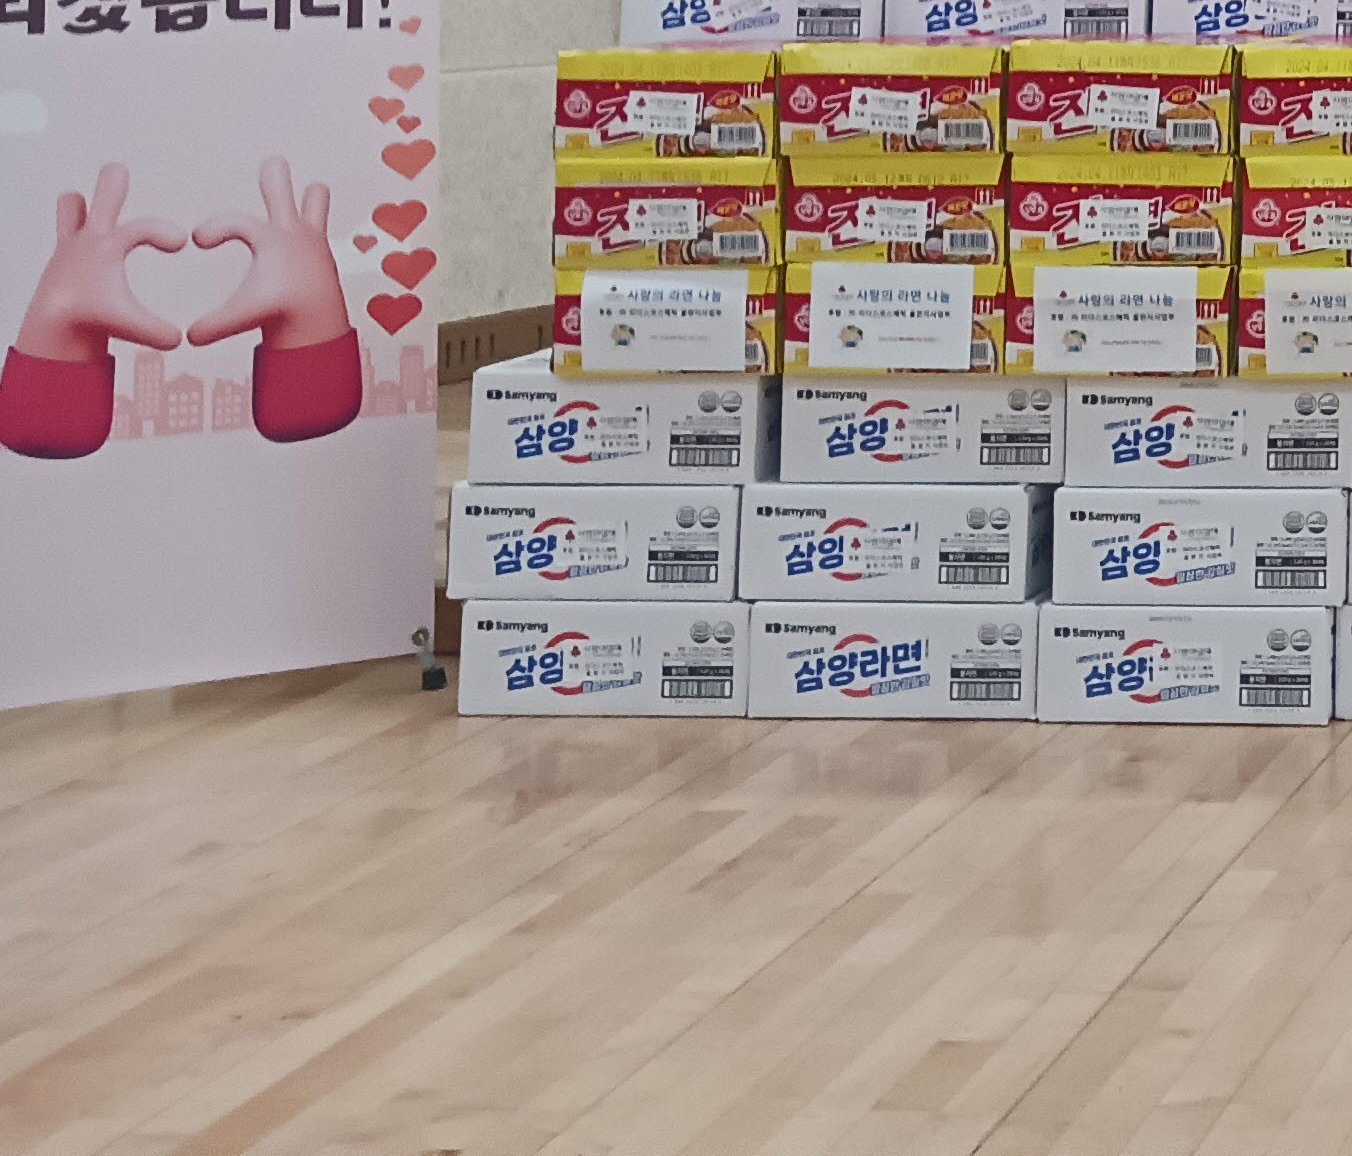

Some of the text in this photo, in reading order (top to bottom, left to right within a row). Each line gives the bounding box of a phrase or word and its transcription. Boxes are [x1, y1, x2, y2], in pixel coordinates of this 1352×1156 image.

[628, 289, 721, 303] 사랑의 라면 나눔
[857, 289, 950, 304] 사랑의 라면 나눔
[1078, 295, 1173, 307] 사랑의 라면 나눔
[1310, 295, 1346, 309] 사랑의
[517, 419, 579, 458] 삼양
[828, 419, 888, 458] 삼양
[1113, 424, 1175, 464] 삼양
[495, 535, 557, 575] 삼양
[787, 538, 845, 576] 삼양
[1100, 541, 1161, 581] 삼양
[507, 652, 564, 691] 삼양
[796, 640, 922, 693] 삼양라면
[1085, 657, 1148, 698] 삼양
